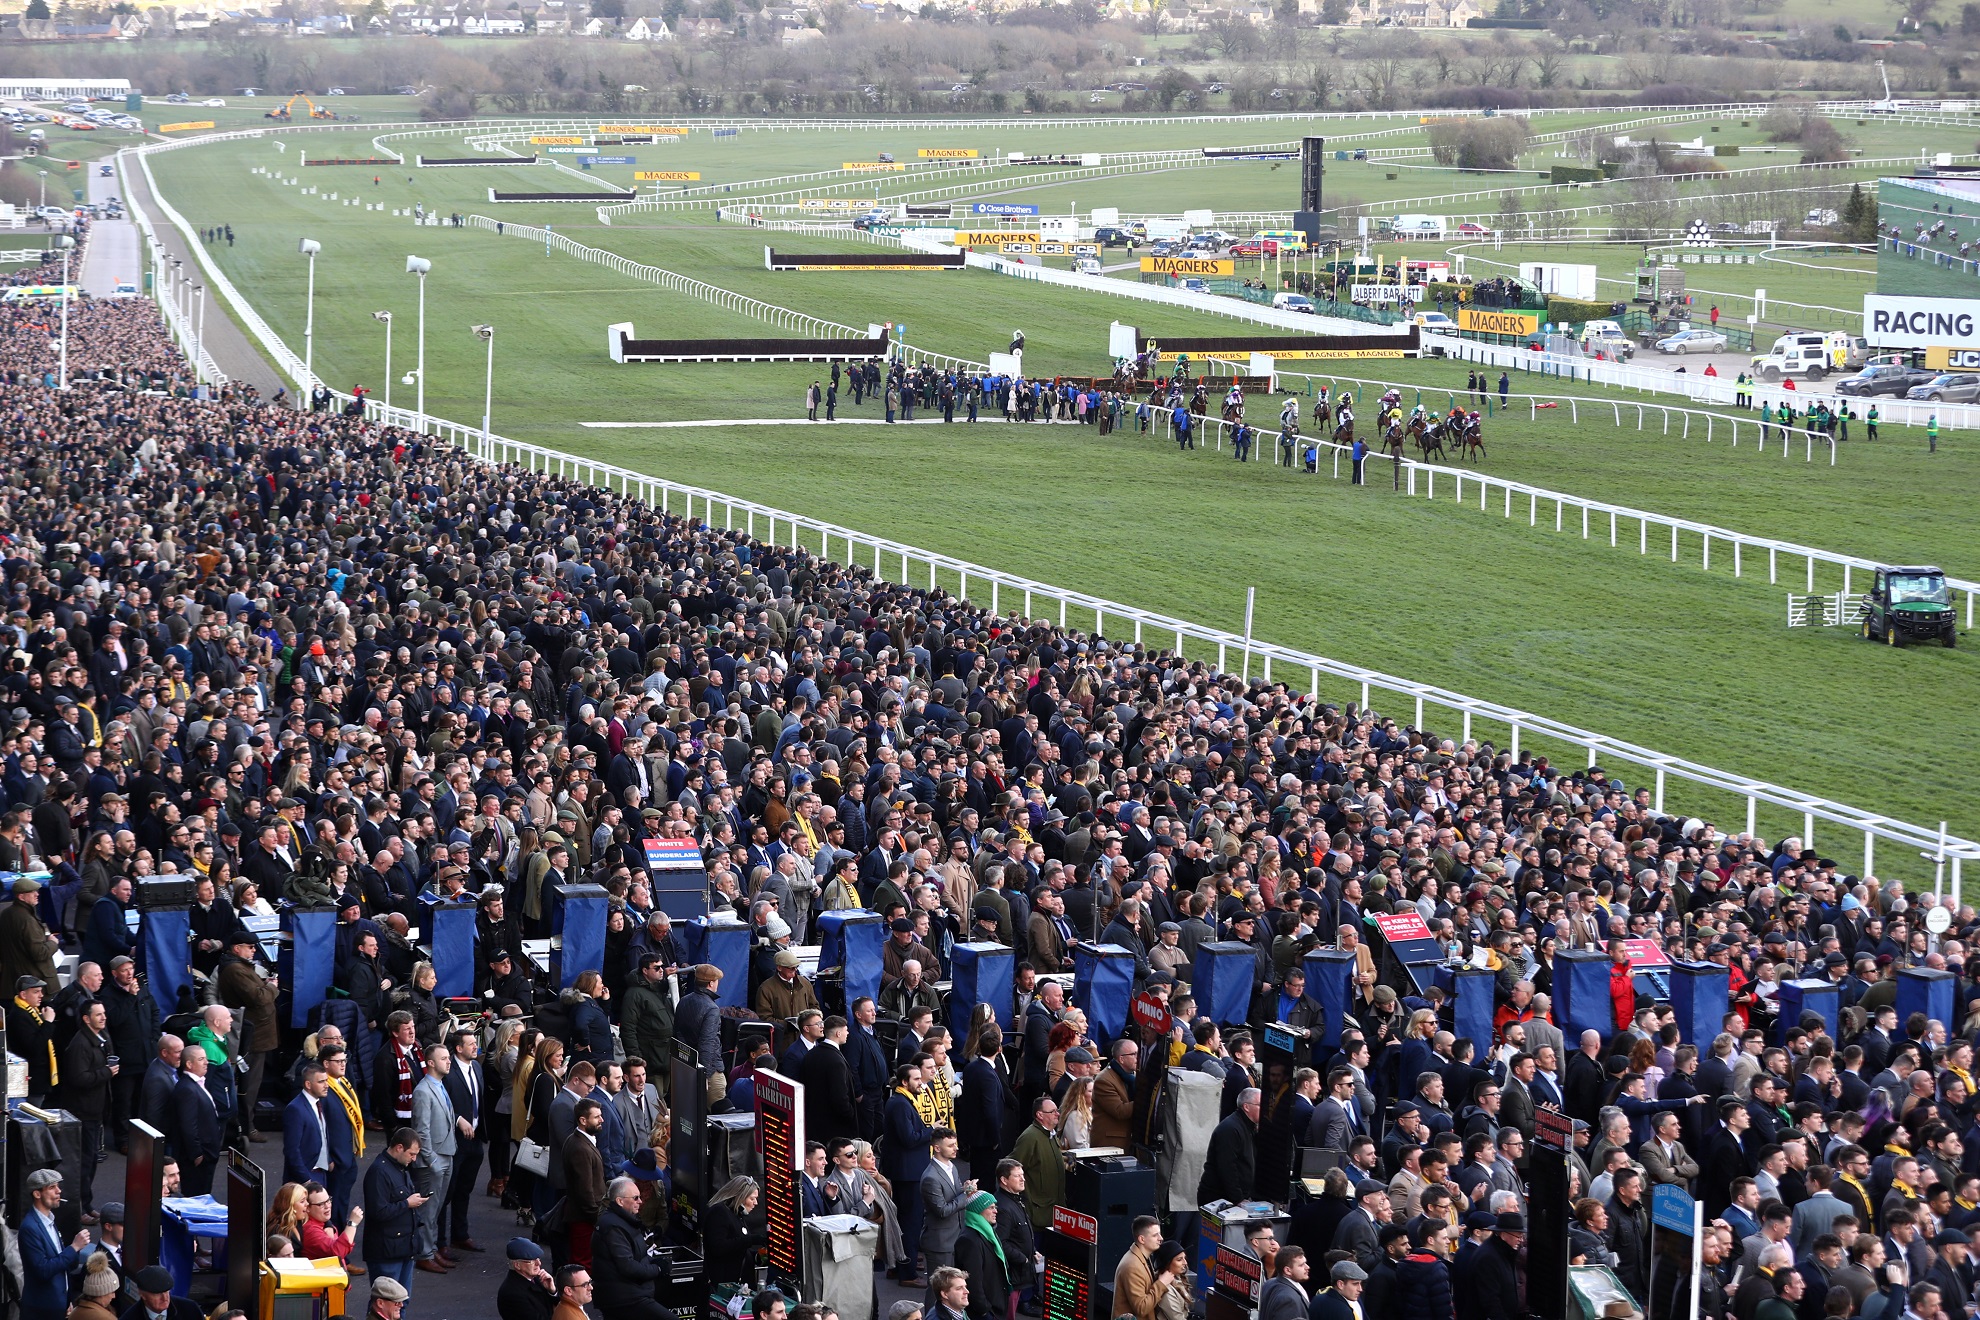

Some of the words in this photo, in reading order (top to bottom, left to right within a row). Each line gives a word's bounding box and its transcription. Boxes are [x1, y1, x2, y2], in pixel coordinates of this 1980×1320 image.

[644, 172, 690, 180] MAGNERS
[802, 200, 824, 208] JCB
[828, 200, 849, 208] JCB
[852, 200, 874, 208] JCB
[1005, 206, 1032, 214] Brothers
[968, 234, 1036, 245] MAGNERS
[1004, 244, 1032, 253] JCB
[1036, 244, 1064, 254] JCB
[1068, 245, 1096, 254] JCB
[1153, 258, 1218, 274] MAGNERS
[1354, 288, 1381, 299] ALBERT
[1470, 312, 1525, 334] MAGNERS
[1873, 310, 1974, 336] RACING
[1949, 351, 1980, 367] JC
[1384, 922, 1424, 931] HOWELLS
[1137, 1000, 1163, 1020] PINNO
[1269, 1036, 1289, 1049] RACING
[1271, 1030, 1288, 1041] ESHER
[768, 1079, 779, 1091] PAUL
[756, 1083, 792, 1110] GARRITTY
[1654, 1185, 1668, 1196] GLEN
[1670, 1187, 1693, 1208] GRAHAM
[1664, 1200, 1683, 1217] Racing
[1055, 1209, 1076, 1228] Barry
[1078, 1215, 1095, 1234] King
[1217, 1247, 1260, 1280] WENSLEYDALE
[1225, 1270, 1249, 1295] RACING
